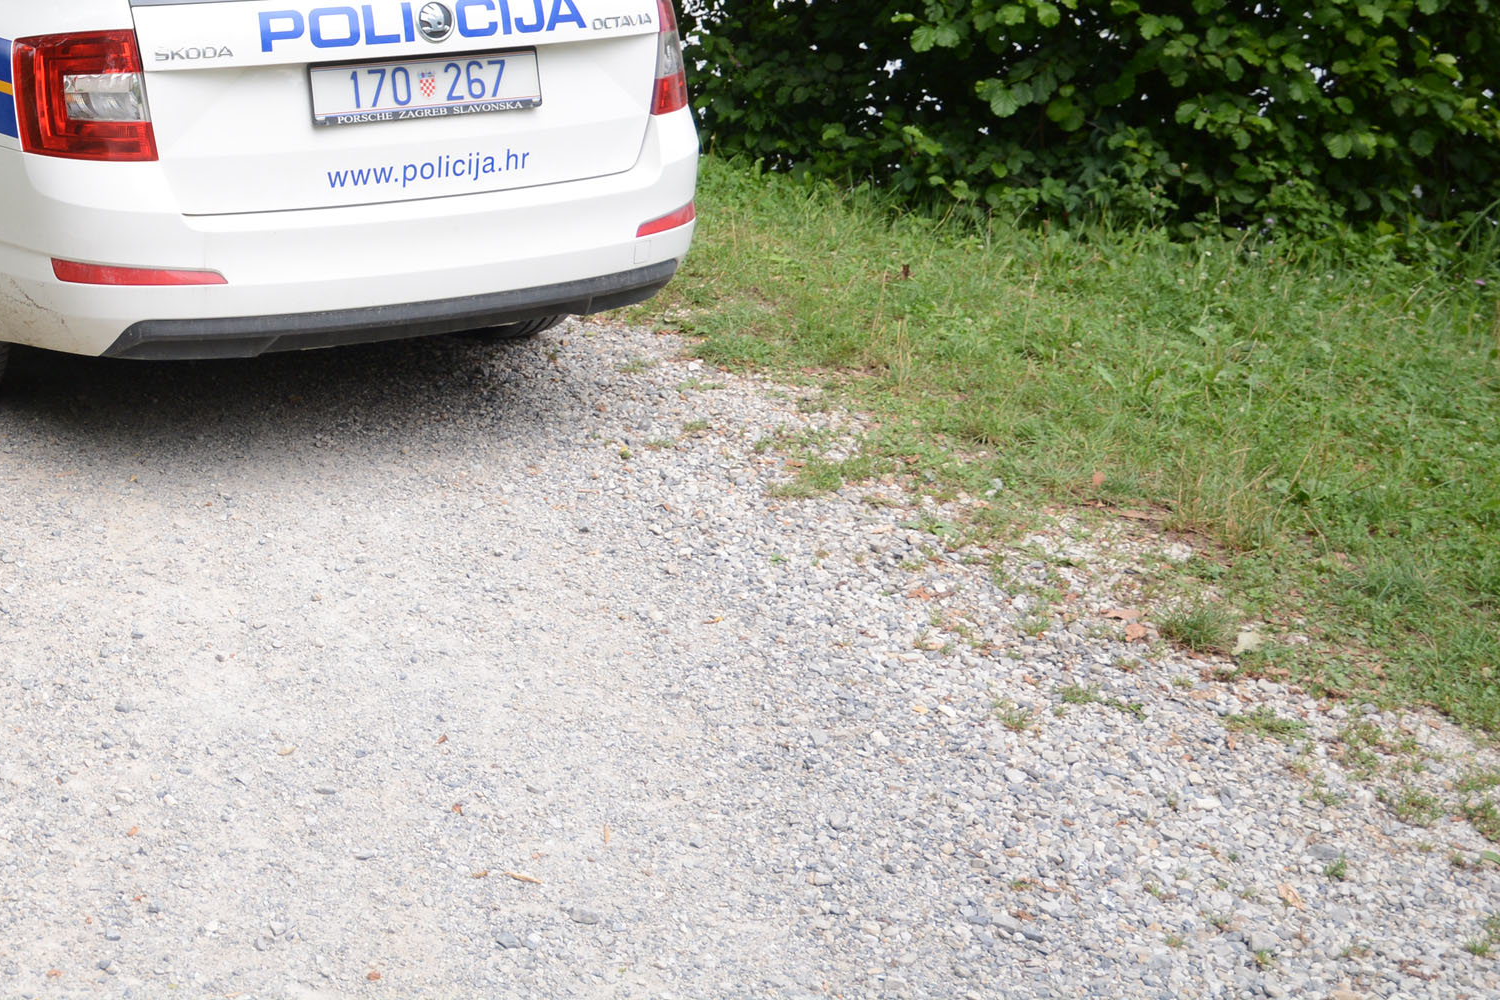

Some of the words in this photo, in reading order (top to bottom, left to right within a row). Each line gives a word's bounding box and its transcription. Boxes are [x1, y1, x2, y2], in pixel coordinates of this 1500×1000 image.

[592, 12, 653, 31] OCTAVIA
[350, 66, 412, 109] 170
[443, 59, 506, 101] 267
[337, 112, 393, 125] PORSCHE
[398, 107, 448, 119] ZAGREB
[453, 100, 524, 114] SLAVONSKA
[327, 148, 530, 188] www.policija.hr
